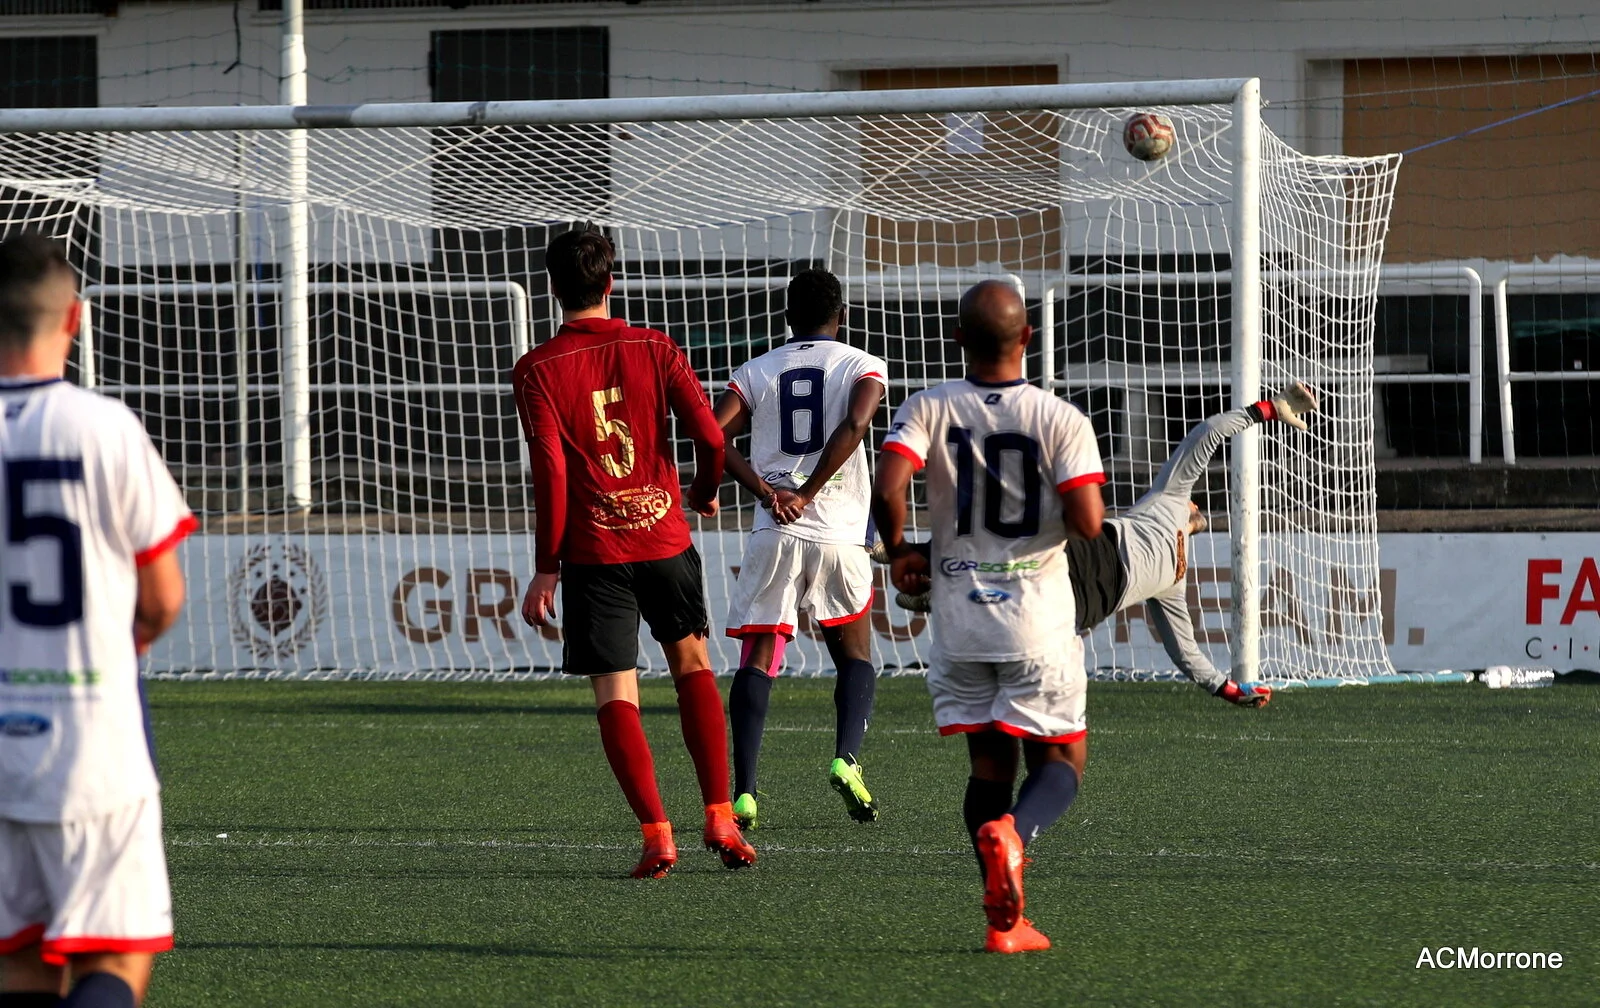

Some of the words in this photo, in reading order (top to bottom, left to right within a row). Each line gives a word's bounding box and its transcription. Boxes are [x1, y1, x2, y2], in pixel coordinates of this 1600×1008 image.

[592, 386, 634, 478] 5
[778, 366, 826, 457] 8
[947, 425, 1040, 538] 10
[7, 458, 83, 627] 5
